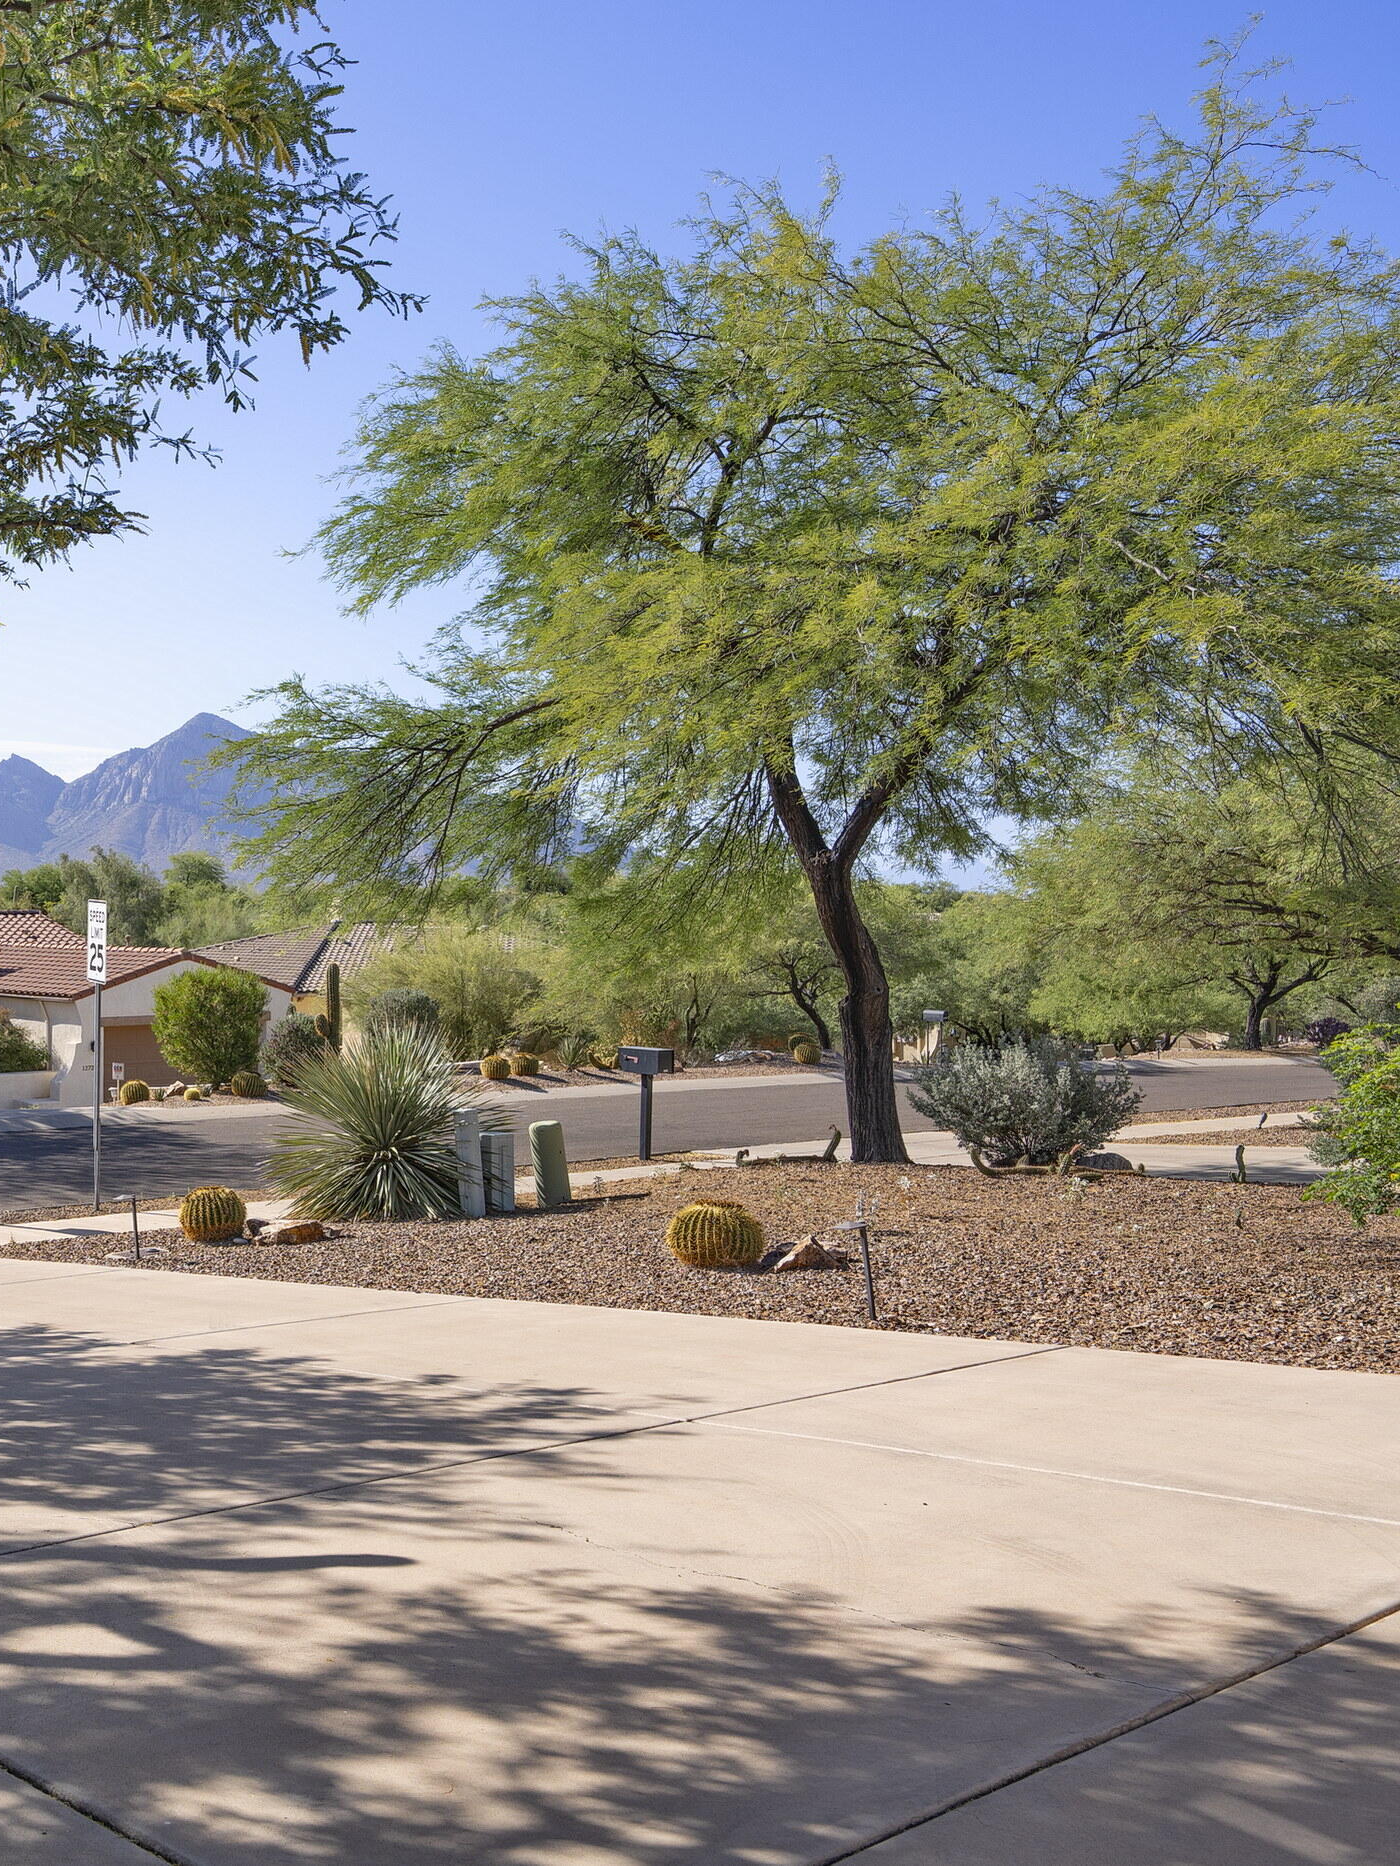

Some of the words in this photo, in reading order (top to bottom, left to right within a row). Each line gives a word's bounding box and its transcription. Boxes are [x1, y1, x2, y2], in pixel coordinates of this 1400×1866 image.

[89, 908, 105, 923] SPEED
[90, 923, 105, 938] LIMIT
[89, 942, 104, 973] 25
